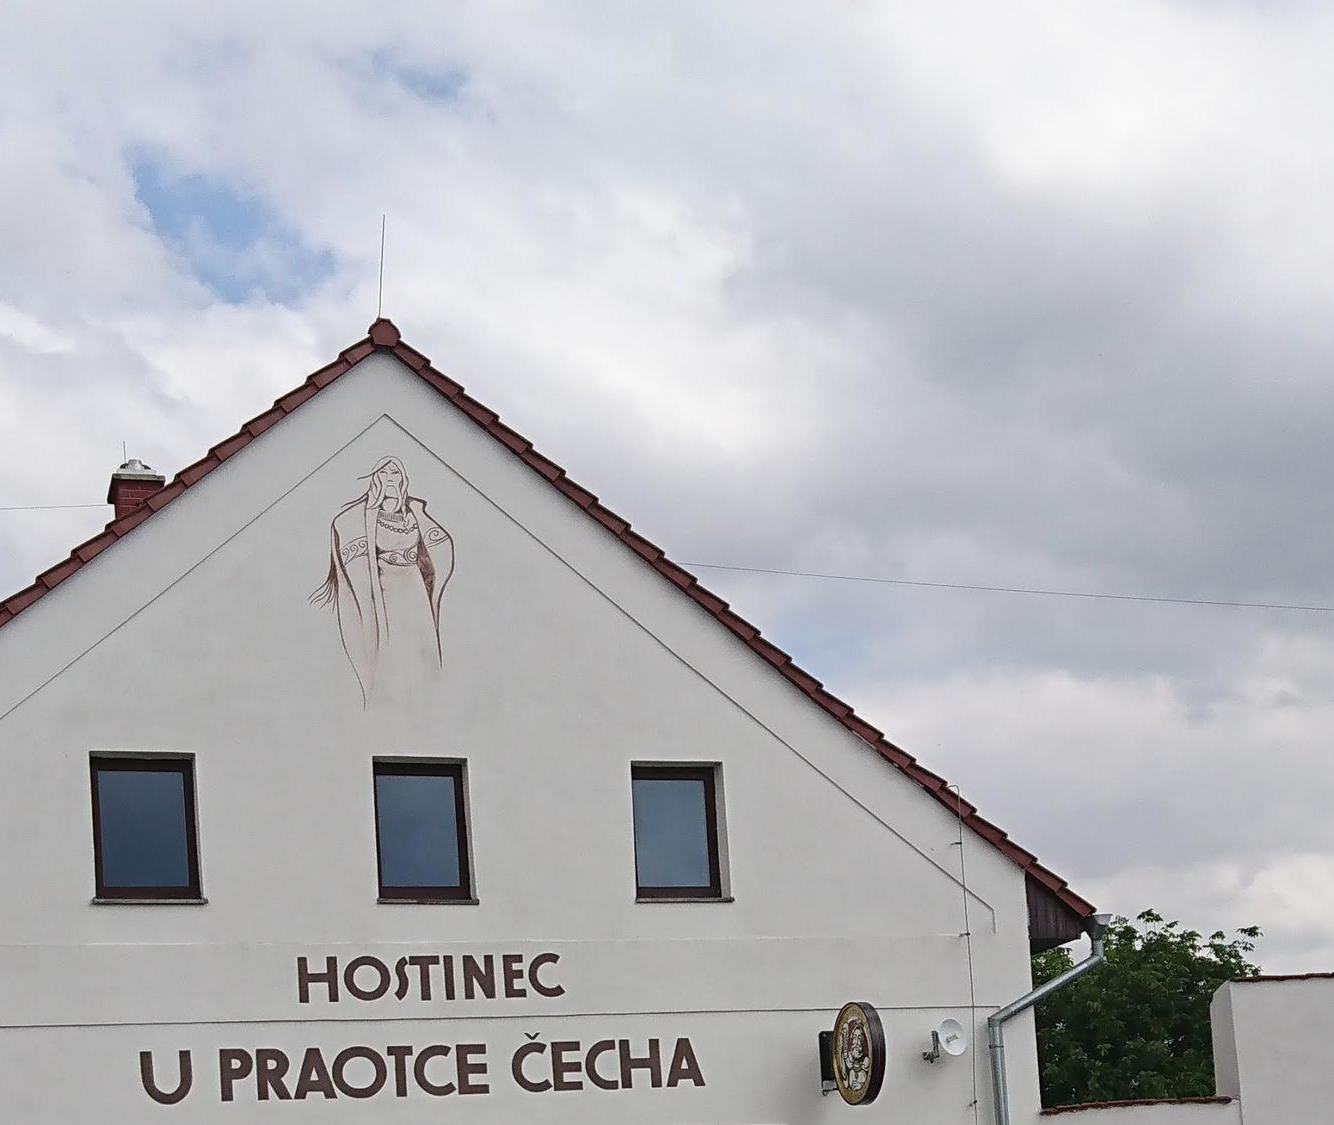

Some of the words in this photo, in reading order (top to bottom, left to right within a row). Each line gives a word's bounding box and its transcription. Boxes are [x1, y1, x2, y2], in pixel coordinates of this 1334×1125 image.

[297, 952, 566, 1004] HOSTINEC
[139, 1049, 193, 1106] U
[218, 1043, 490, 1102] PRAOTCE
[511, 1032, 706, 1093] ČECHA
